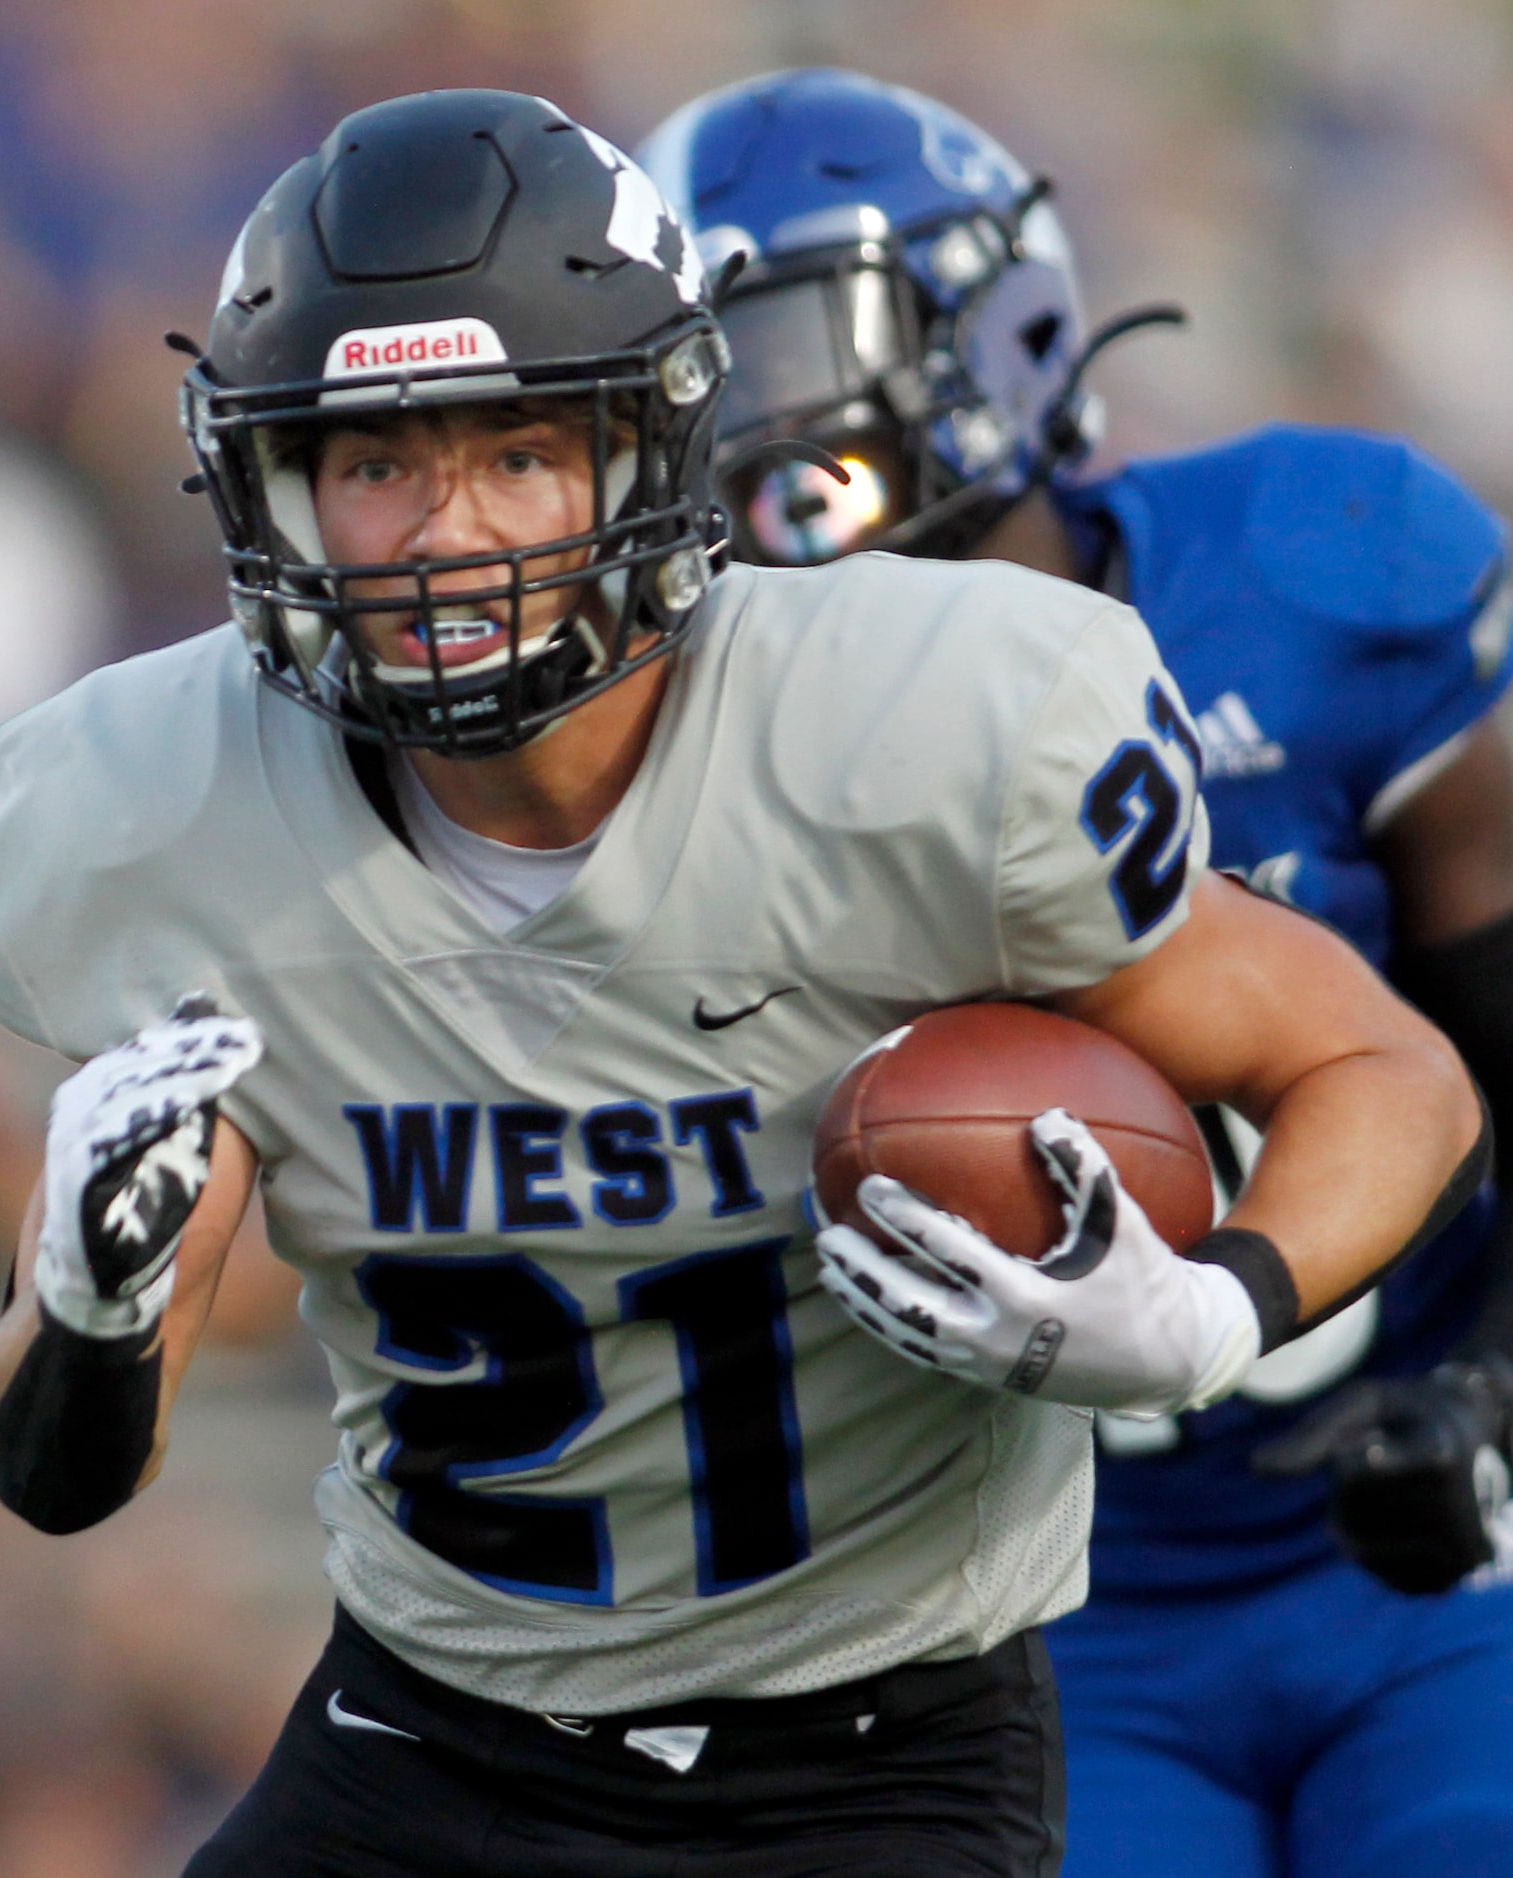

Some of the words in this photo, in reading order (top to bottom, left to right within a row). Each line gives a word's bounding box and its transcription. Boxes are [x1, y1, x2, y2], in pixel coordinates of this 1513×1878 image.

[344, 331, 479, 369] Riddell
[342, 1085, 765, 1233] WEST
[353, 1234, 812, 1607] 21
